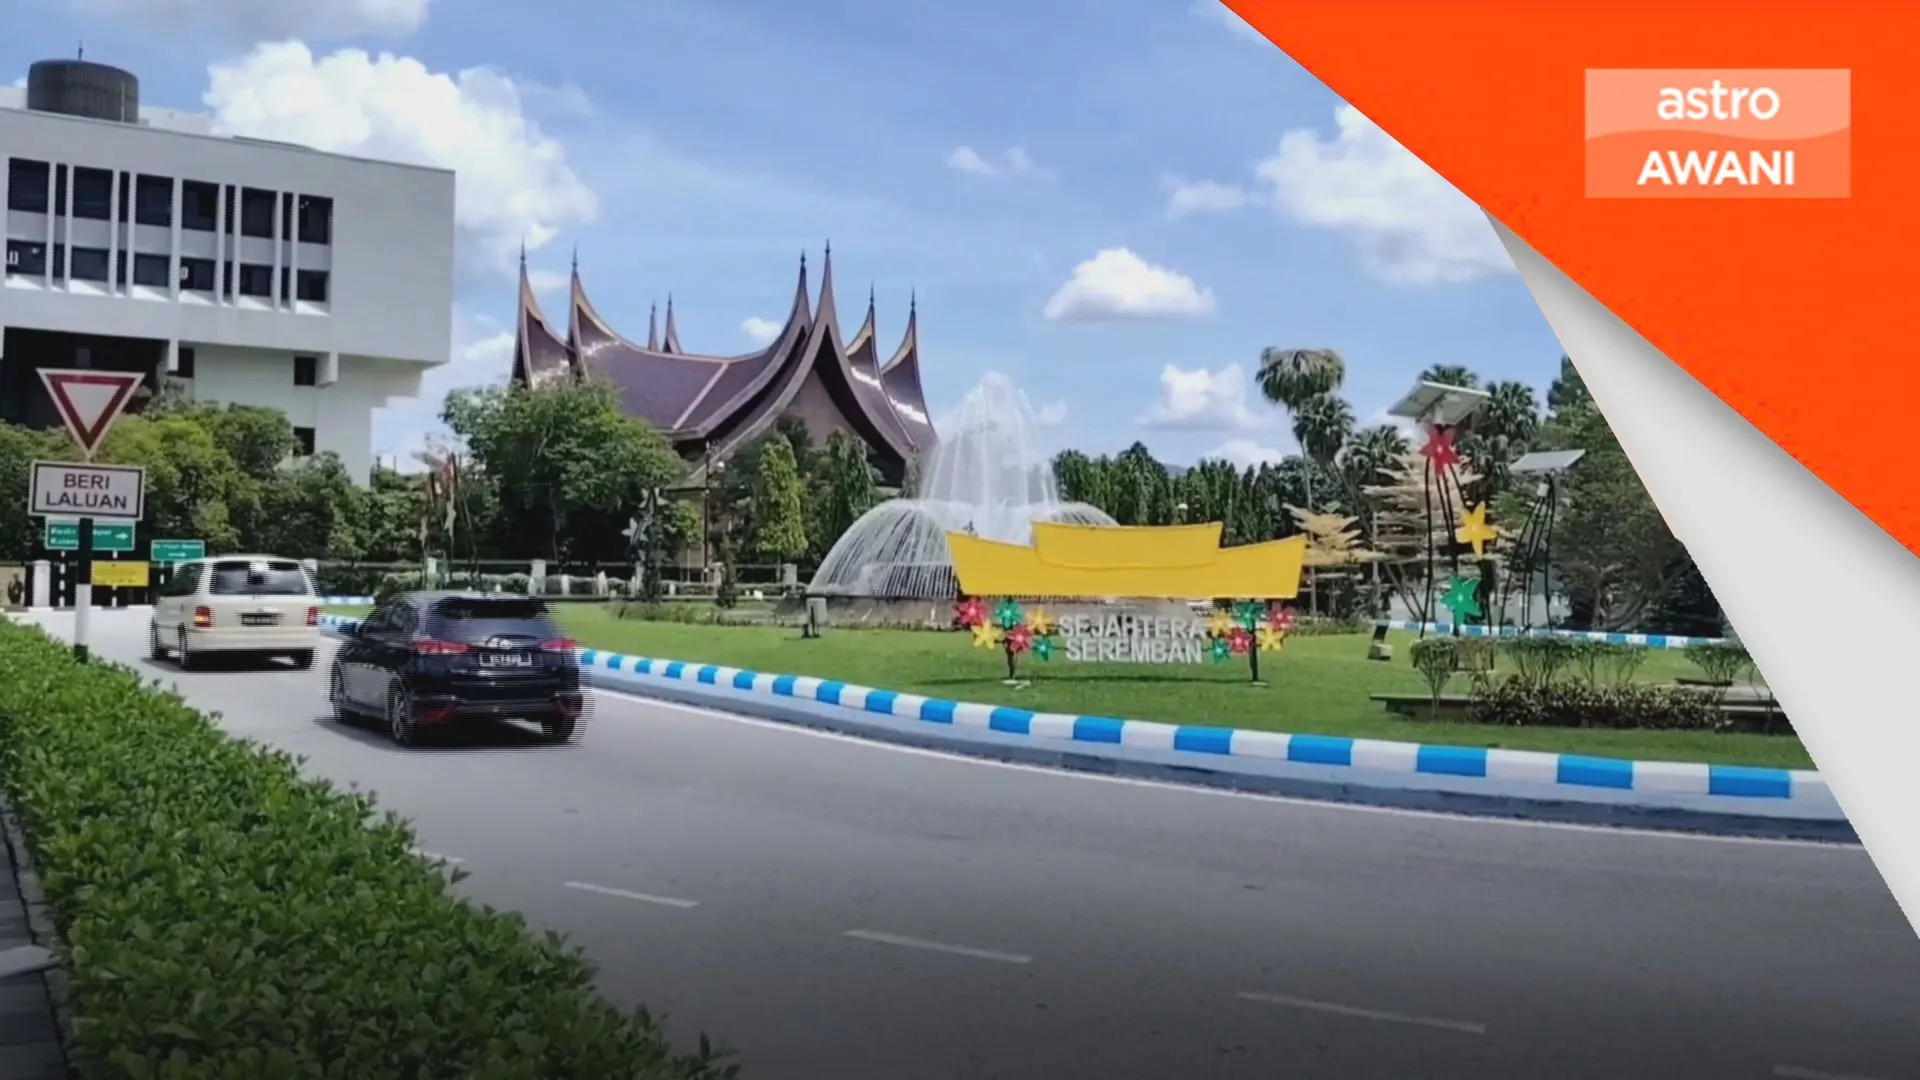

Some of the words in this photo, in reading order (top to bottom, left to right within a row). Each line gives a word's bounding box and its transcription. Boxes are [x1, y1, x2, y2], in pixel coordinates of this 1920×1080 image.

[63, 473, 110, 490] BERI
[46, 491, 127, 509] LALUAN
[1059, 613, 1207, 639] SEJAHTERA
[1066, 638, 1203, 663] SEREMBAN
